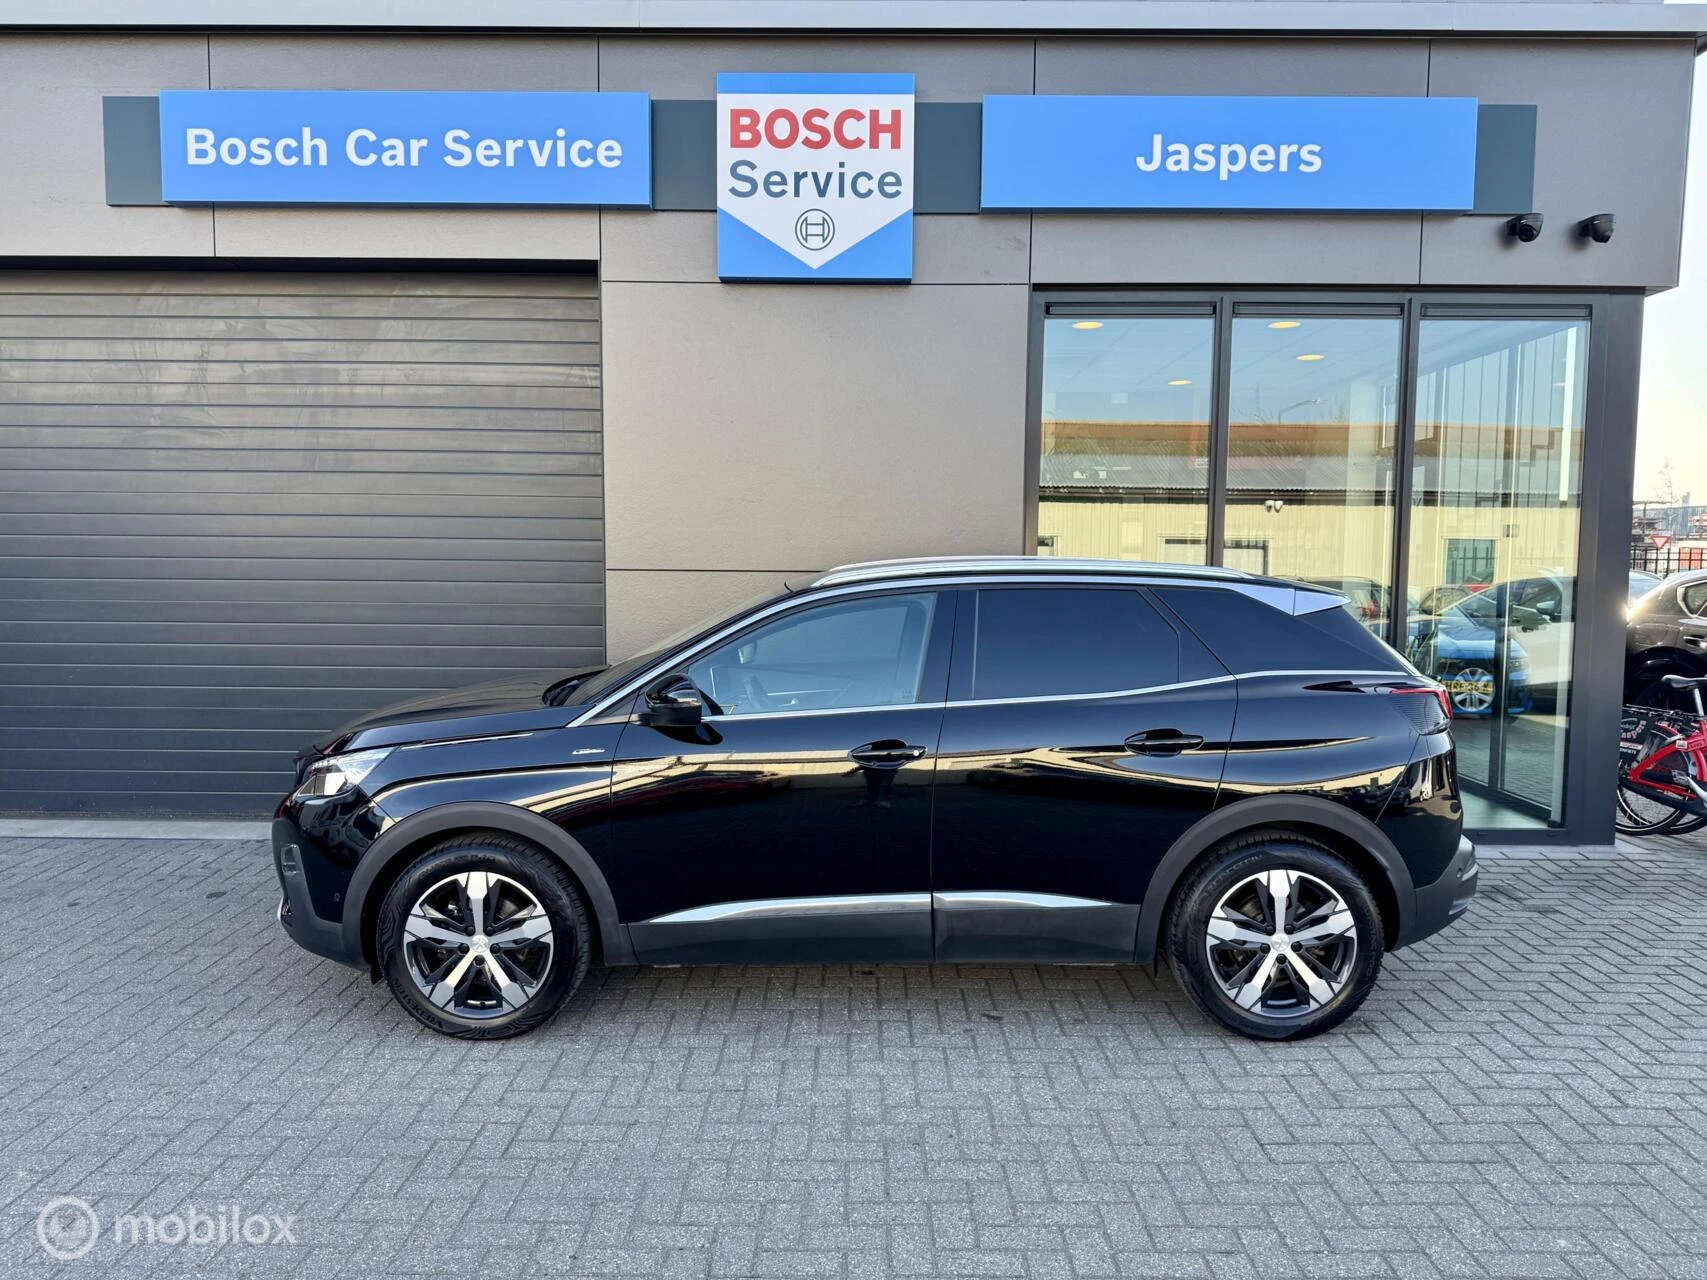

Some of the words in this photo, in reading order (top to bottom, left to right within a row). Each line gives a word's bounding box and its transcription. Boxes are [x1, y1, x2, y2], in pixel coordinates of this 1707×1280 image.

[185, 127, 328, 166] Bosch
[345, 128, 428, 167] Car
[443, 128, 623, 168] Service
[730, 108, 901, 150] BOSCH
[1135, 134, 1322, 181] Jaspers
[728, 159, 903, 199] Service
[1620, 720, 1647, 739] aspers
